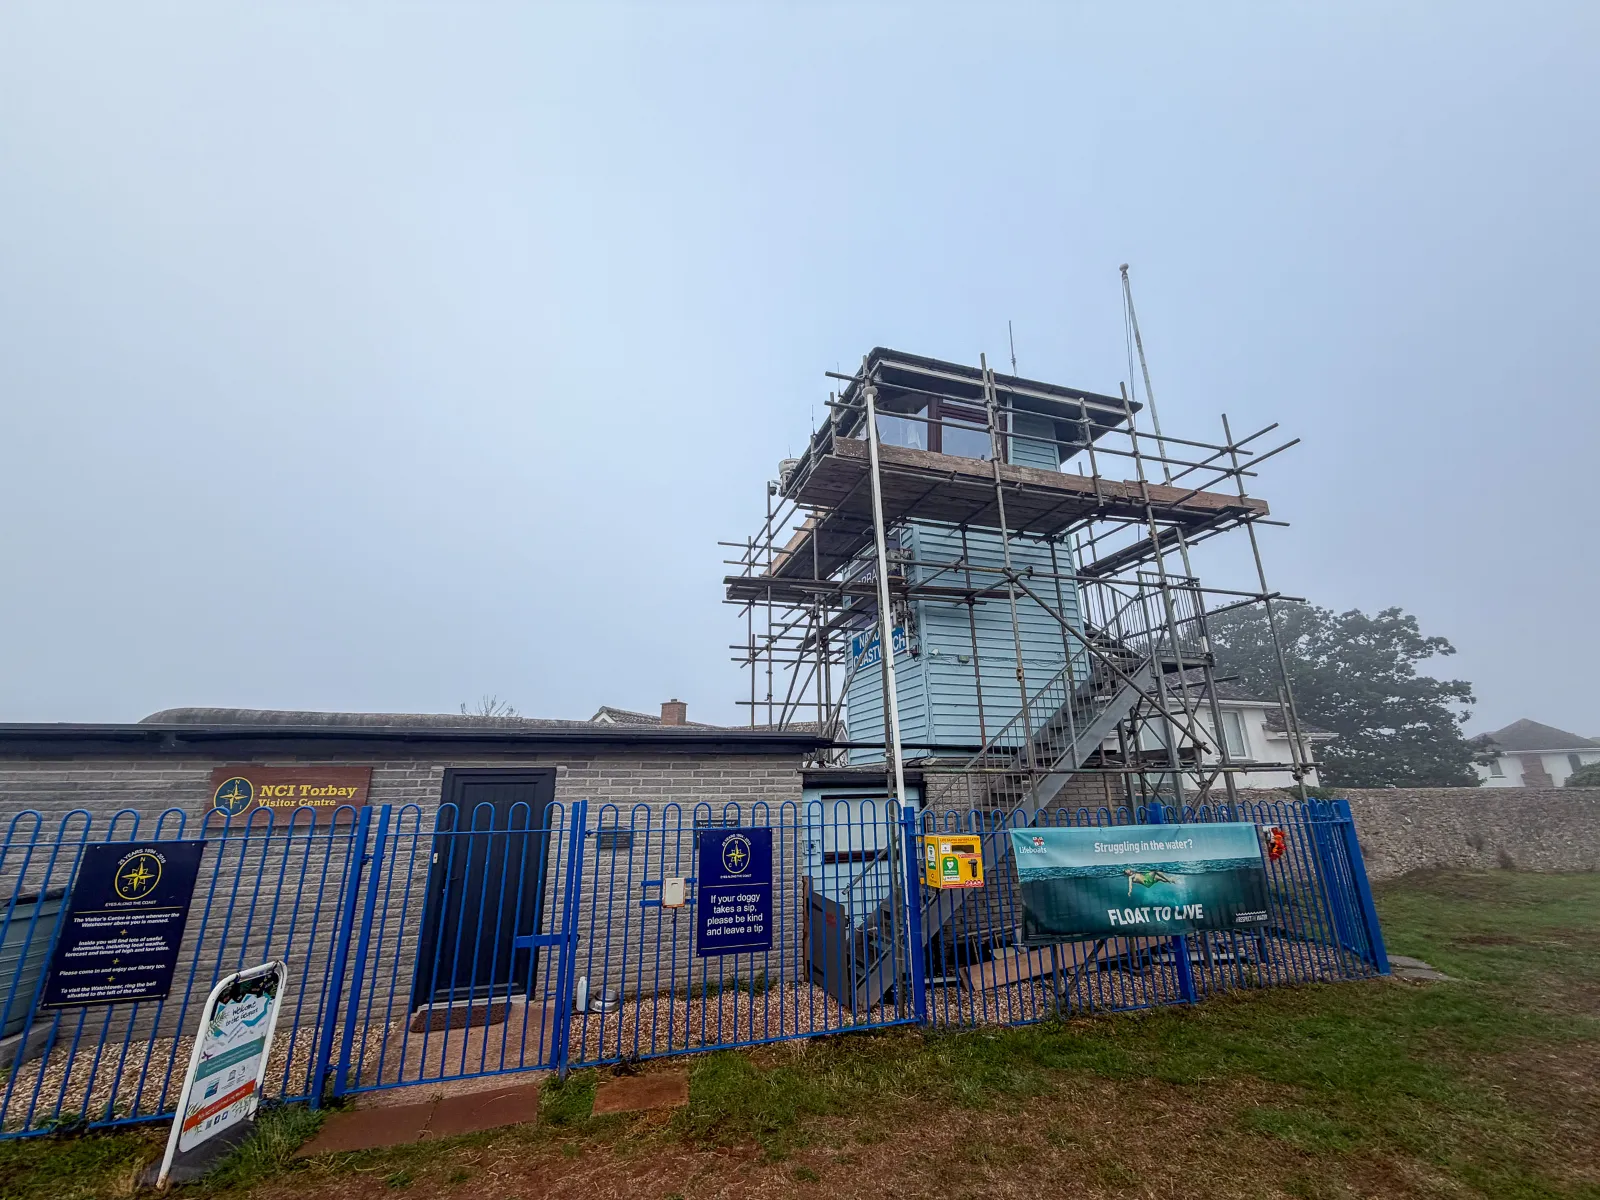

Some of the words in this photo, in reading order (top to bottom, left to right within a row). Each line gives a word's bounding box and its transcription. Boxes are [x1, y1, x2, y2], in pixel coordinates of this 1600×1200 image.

[260, 785, 296, 796] NCI
[300, 784, 358, 798] Torbay
[258, 798, 296, 807] Visitor
[298, 798, 336, 806] Centre
[1094, 841, 1140, 854] Struggling
[1141, 840, 1149, 851] in
[1149, 840, 1164, 851] the
[1165, 838, 1193, 850] water?
[123, 848, 144, 860] YEARS
[710, 894, 716, 904] If
[718, 895, 736, 904] your
[737, 894, 760, 902] doggy
[714, 905, 735, 914] takes
[744, 904, 757, 913] sip,
[1108, 907, 1150, 926] FLOAT
[1152, 906, 1172, 922] TO
[1174, 904, 1204, 920] LIVE
[707, 916, 733, 927] please
[735, 914, 746, 923] be
[747, 912, 763, 922] kind
[706, 926, 722, 936] and
[724, 926, 745, 934] leave
[754, 924, 763, 933] tip
